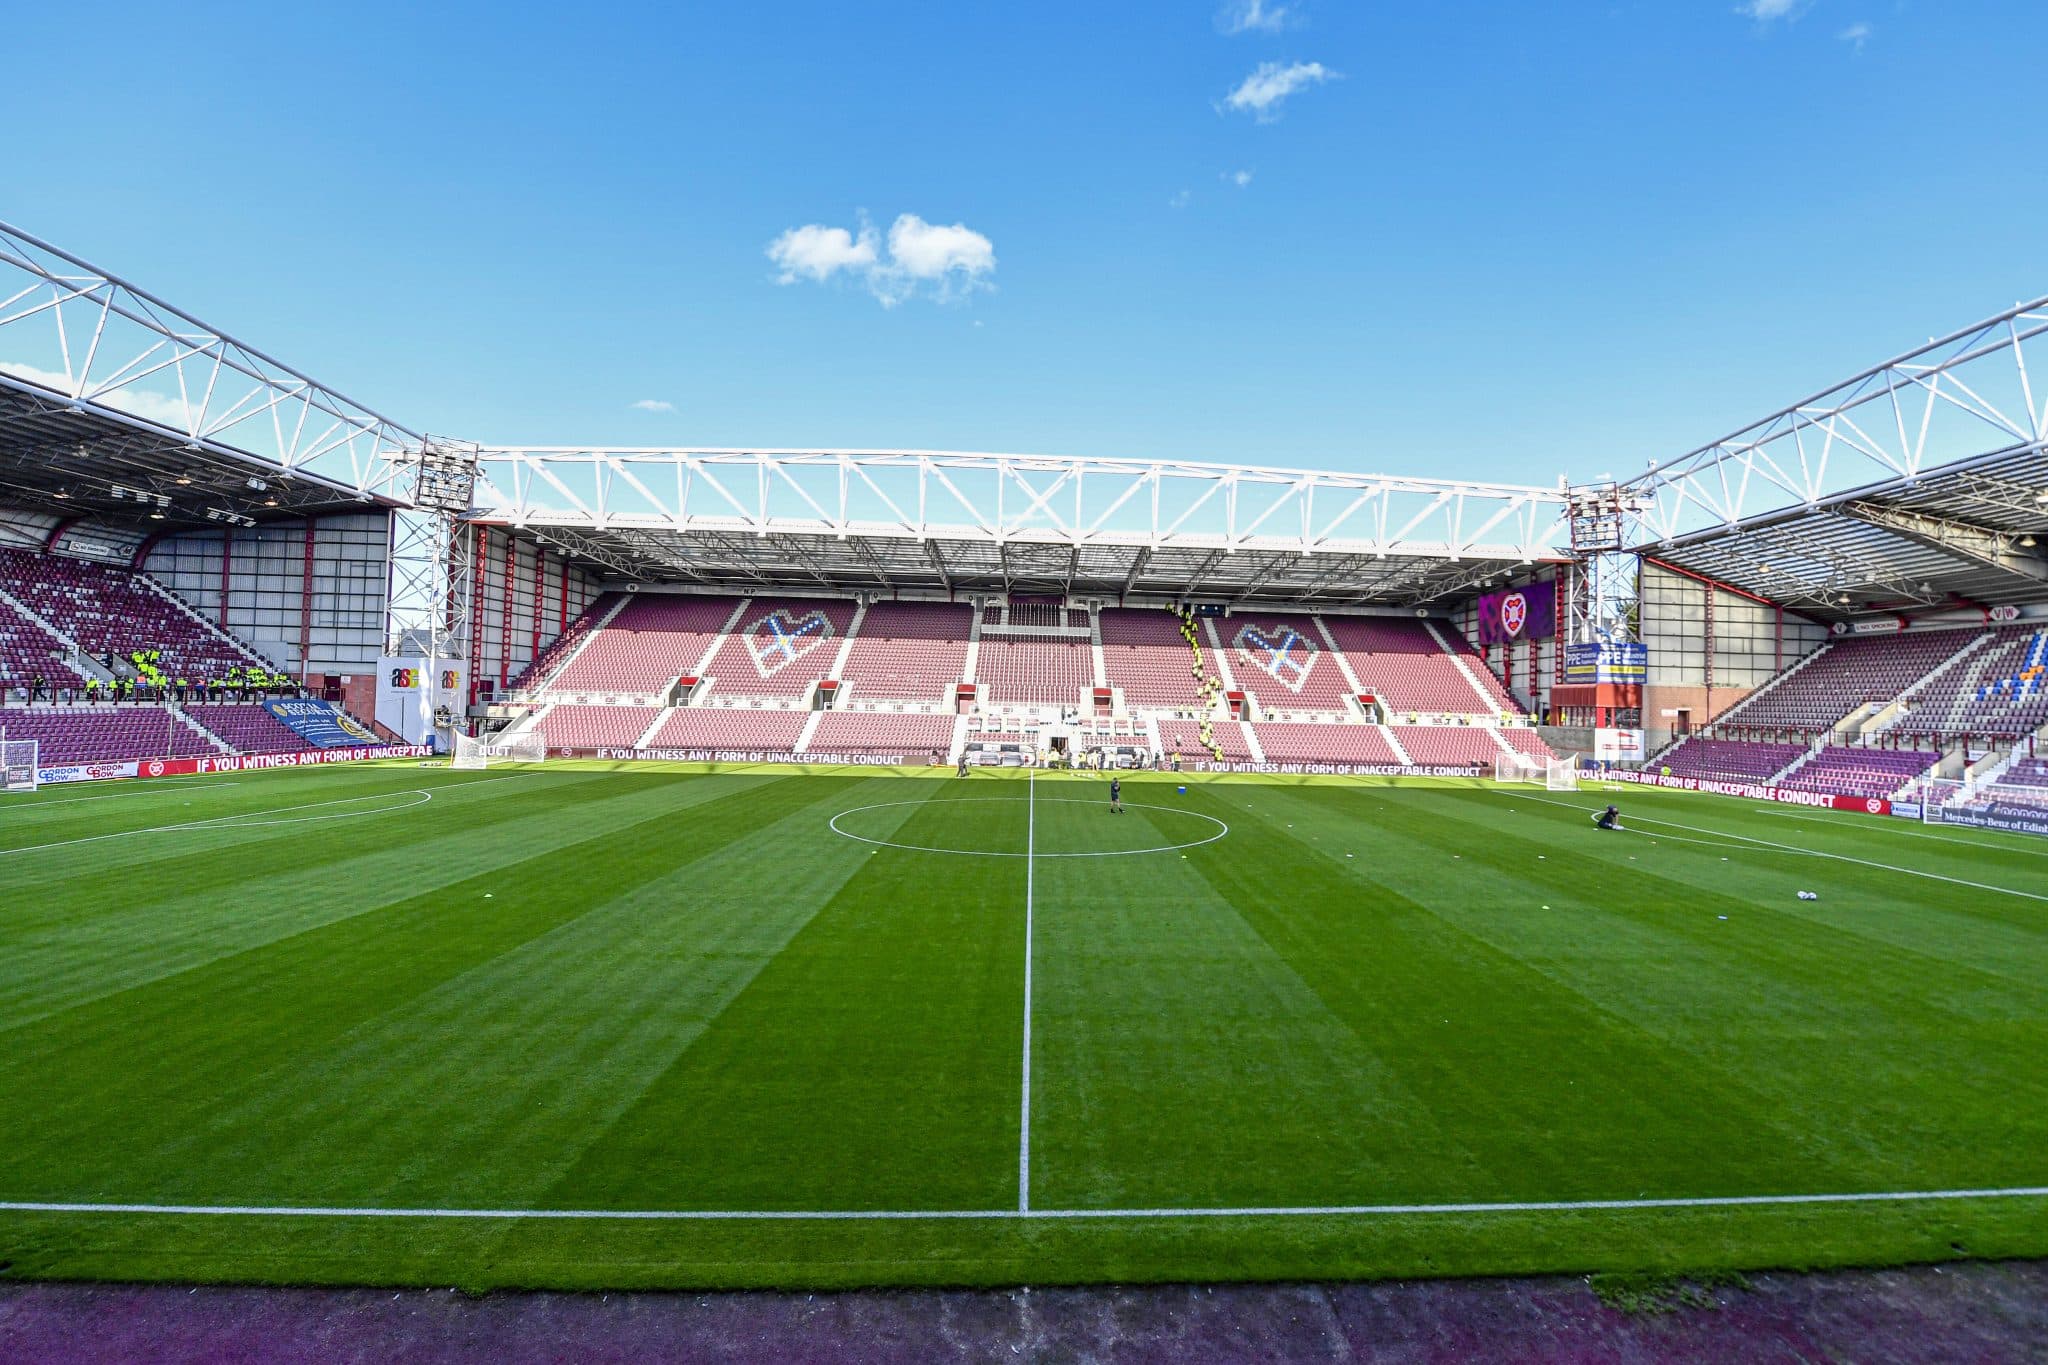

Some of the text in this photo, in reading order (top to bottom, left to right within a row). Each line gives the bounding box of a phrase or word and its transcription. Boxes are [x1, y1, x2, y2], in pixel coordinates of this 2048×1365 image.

[1567, 652, 1581, 665] PPE
[1599, 651, 1621, 665] PPE
[197, 759, 209, 773] IF
[213, 757, 240, 772] YOU
[242, 752, 297, 769] WITNESS
[299, 751, 321, 765] ANY
[323, 749, 351, 763] FORM
[354, 748, 366, 760] OF
[597, 749, 905, 765] IF YOU WITNESS ANY FORM OF UNACCEPTABLE CONDUCT
[86, 764, 124, 776] GORDON
[1195, 761, 1481, 777] IF YOU WITNESS ANY FORM OF UNACCEPTABLE CONDUCT
[1574, 768, 1600, 780] YOU
[1602, 769, 1640, 783] WITNESS
[1640, 773, 1658, 785] ANY
[1659, 775, 1683, 789] FORM
[1684, 778, 1697, 790] OF
[1698, 779, 1776, 801] UNACCEPTABLE
[1777, 788, 1836, 808] CONDUCT
[1944, 811, 2010, 829] Mercedes-Benz
[2011, 820, 2021, 830] of
